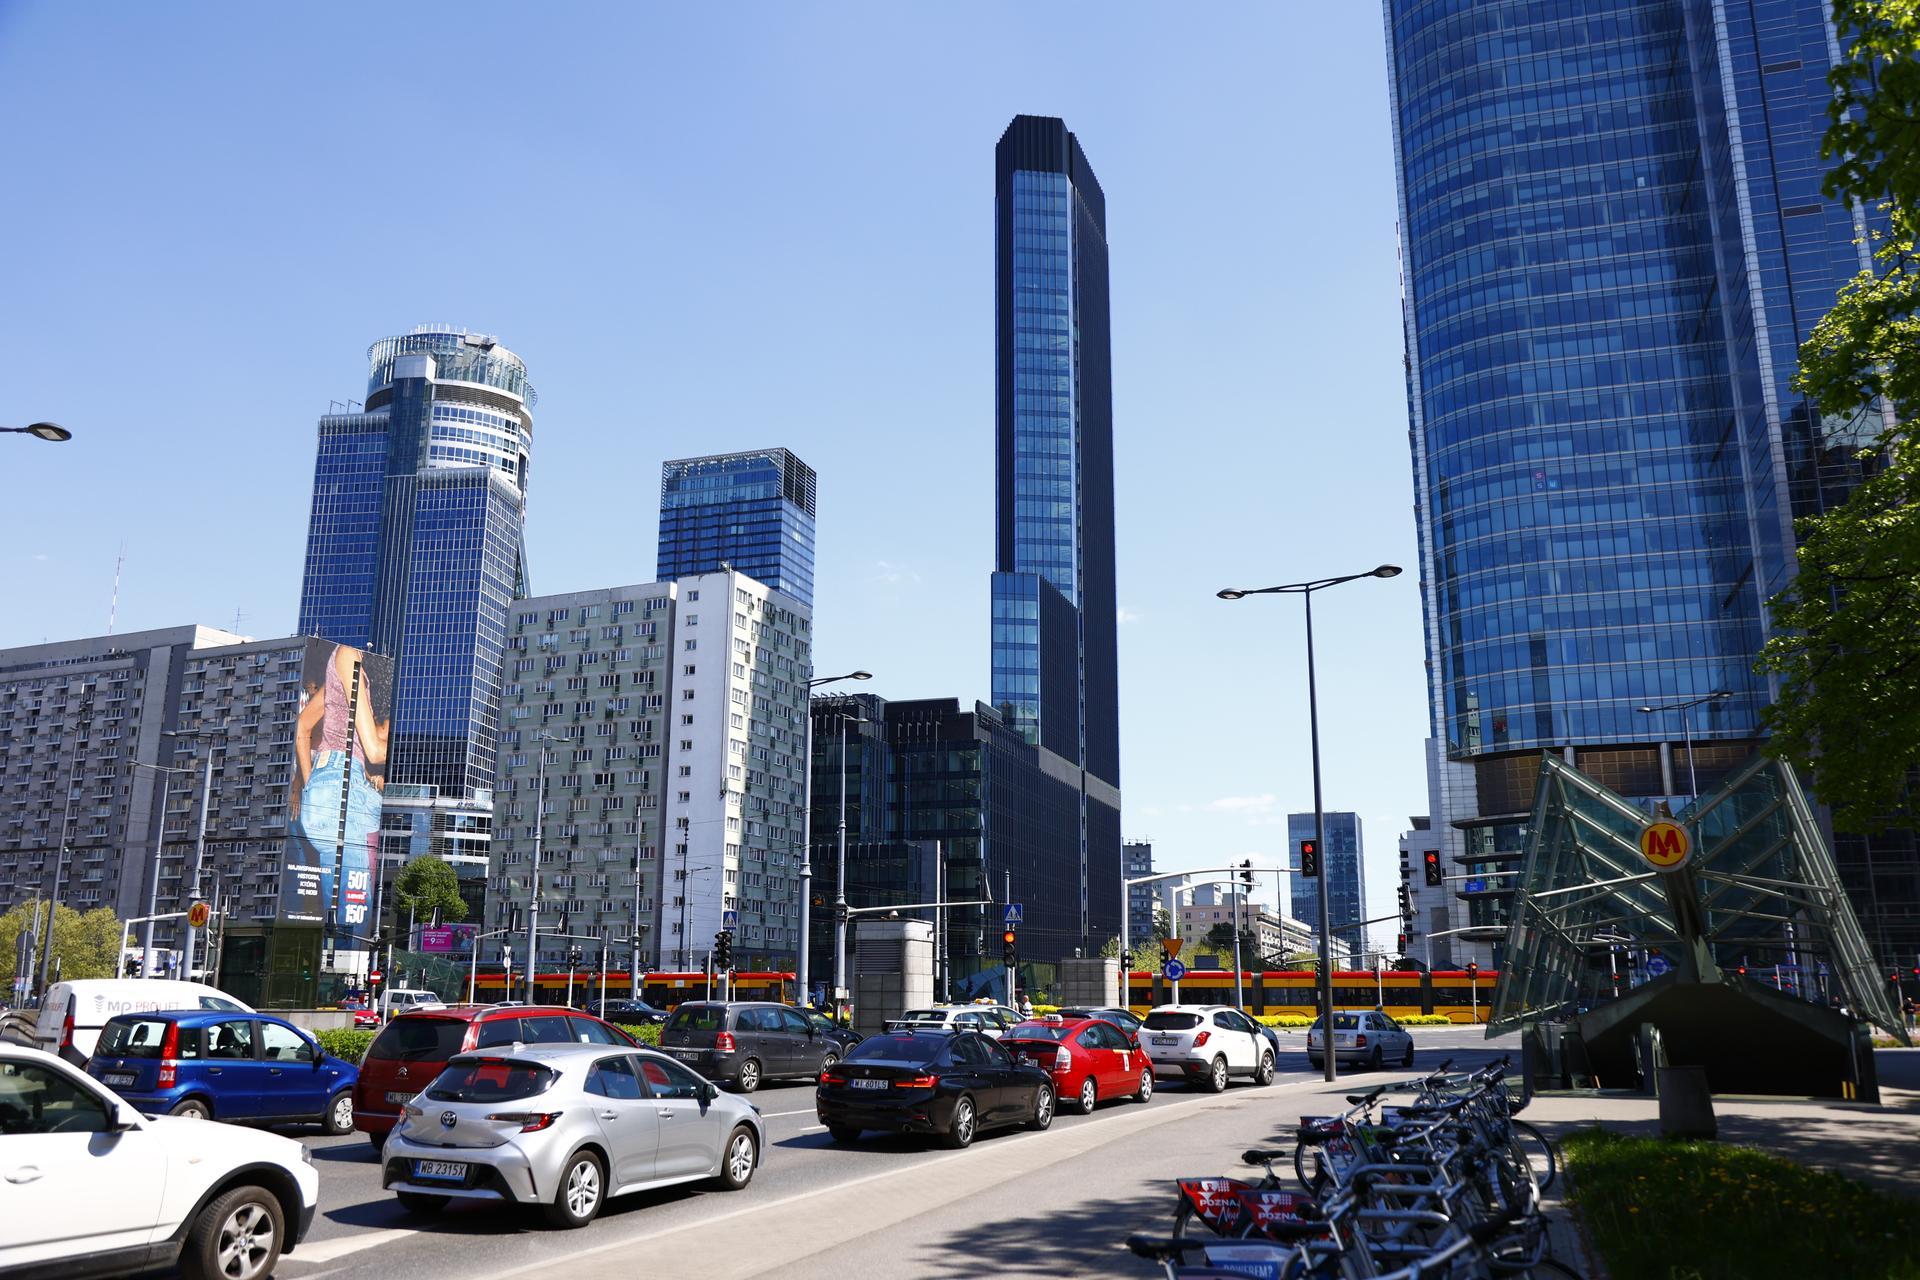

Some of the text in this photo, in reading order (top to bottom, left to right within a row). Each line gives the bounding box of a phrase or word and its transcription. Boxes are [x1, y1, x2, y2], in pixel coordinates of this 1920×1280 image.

[1648, 830, 1682, 858] M
[421, 1161, 465, 1176] WB 2315X
